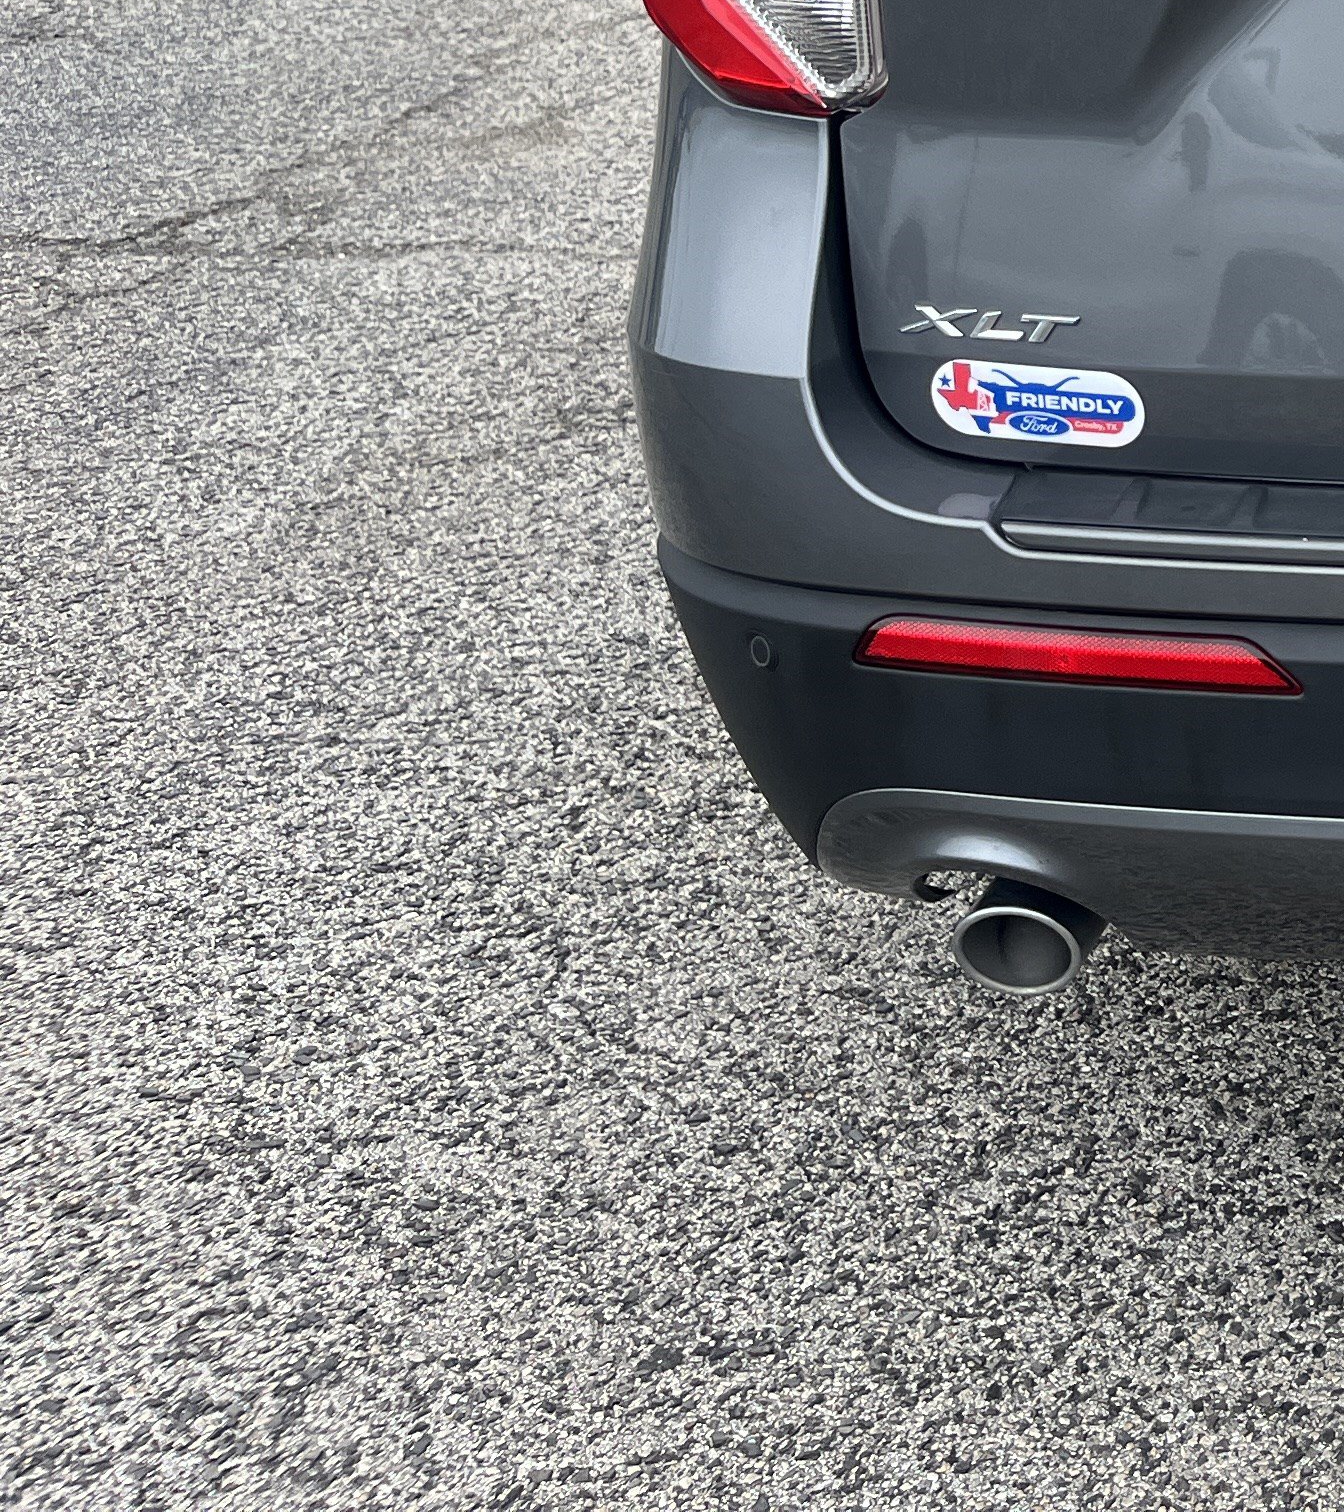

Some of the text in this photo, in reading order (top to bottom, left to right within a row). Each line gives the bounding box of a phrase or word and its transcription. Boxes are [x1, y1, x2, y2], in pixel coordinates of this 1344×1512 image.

[898, 303, 1082, 343] XLT
[1005, 390, 1125, 416] FRIENDLY
[1019, 415, 1058, 435] Ford
